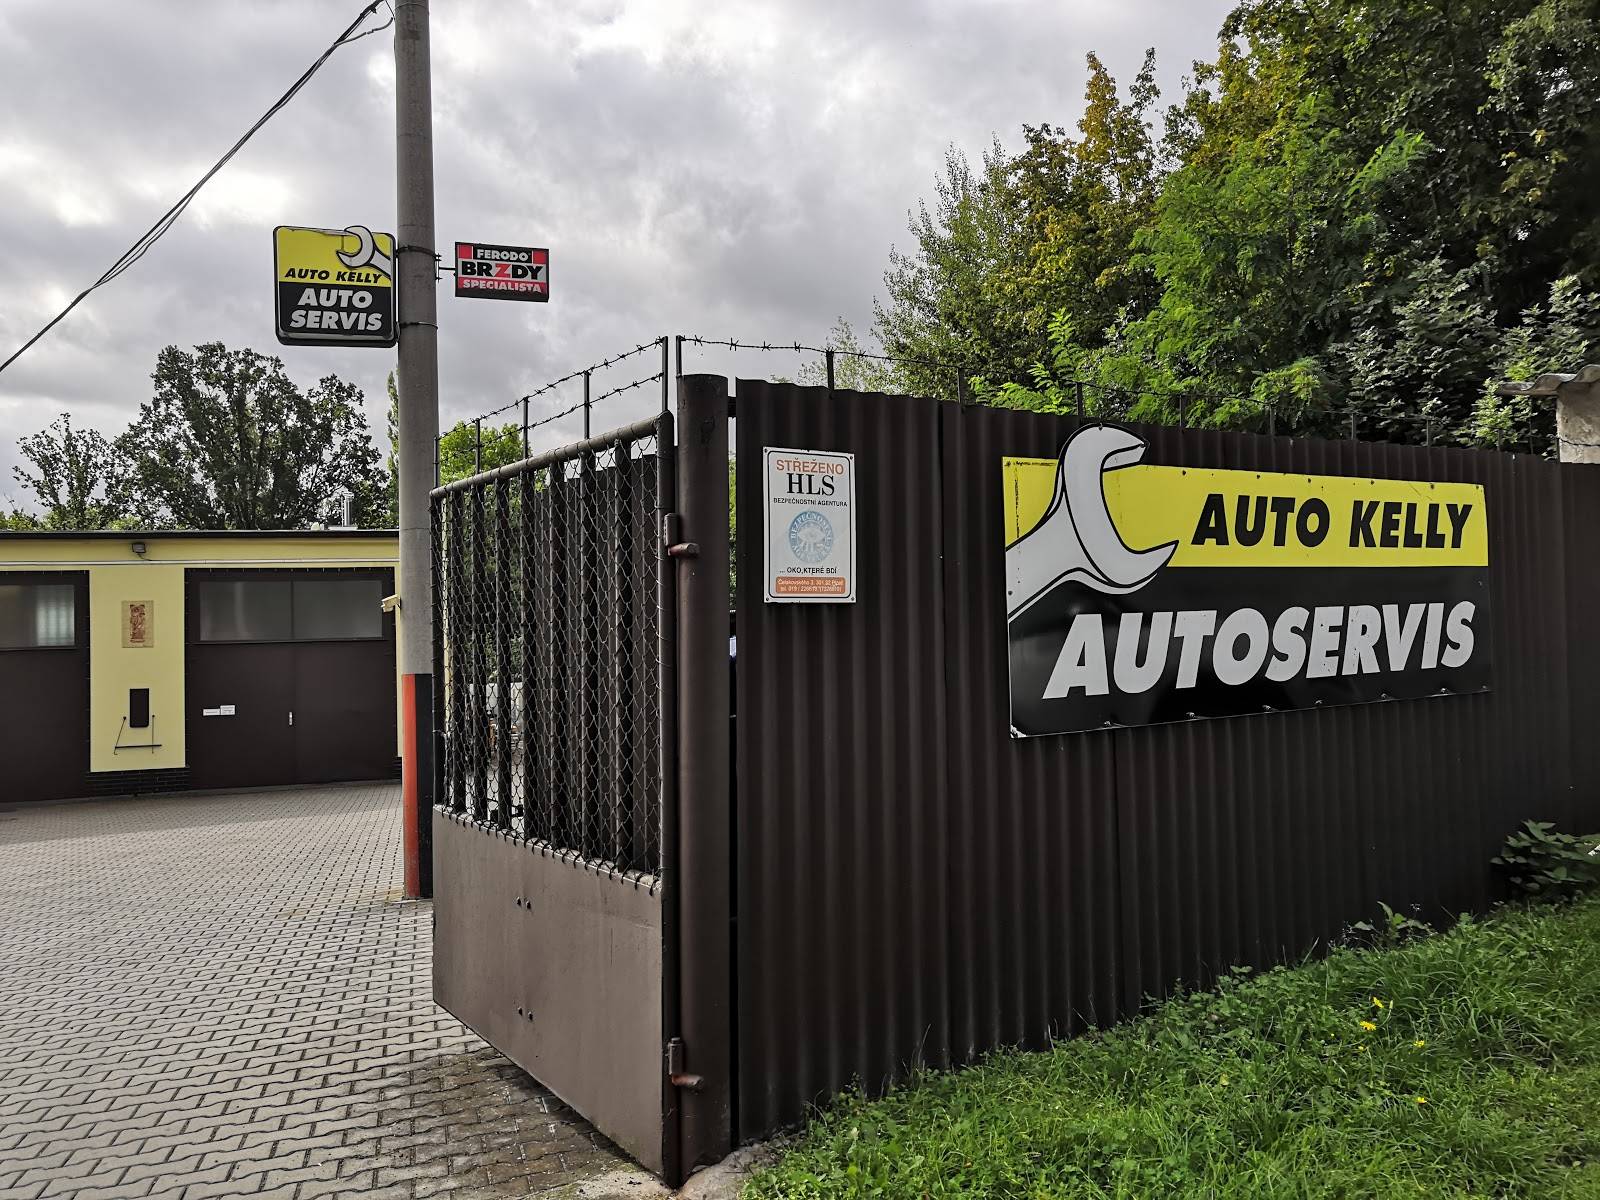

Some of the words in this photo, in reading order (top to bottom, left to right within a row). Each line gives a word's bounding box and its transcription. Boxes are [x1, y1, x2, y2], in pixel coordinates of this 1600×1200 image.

[477, 249, 529, 261] FERODO
[285, 268, 330, 280] AUTO
[336, 271, 383, 283] KELLY
[462, 261, 543, 280] BRZDY
[463, 279, 542, 293] SPECIALISTA
[297, 288, 373, 309] AUTO
[290, 309, 383, 331] SERVIS
[776, 457, 844, 475] STŘEŽENO
[786, 473, 835, 496] HLS
[1191, 493, 1330, 548] AUTO
[1348, 500, 1473, 549] KELLY
[1041, 600, 1476, 700] AUTOSERVIS
